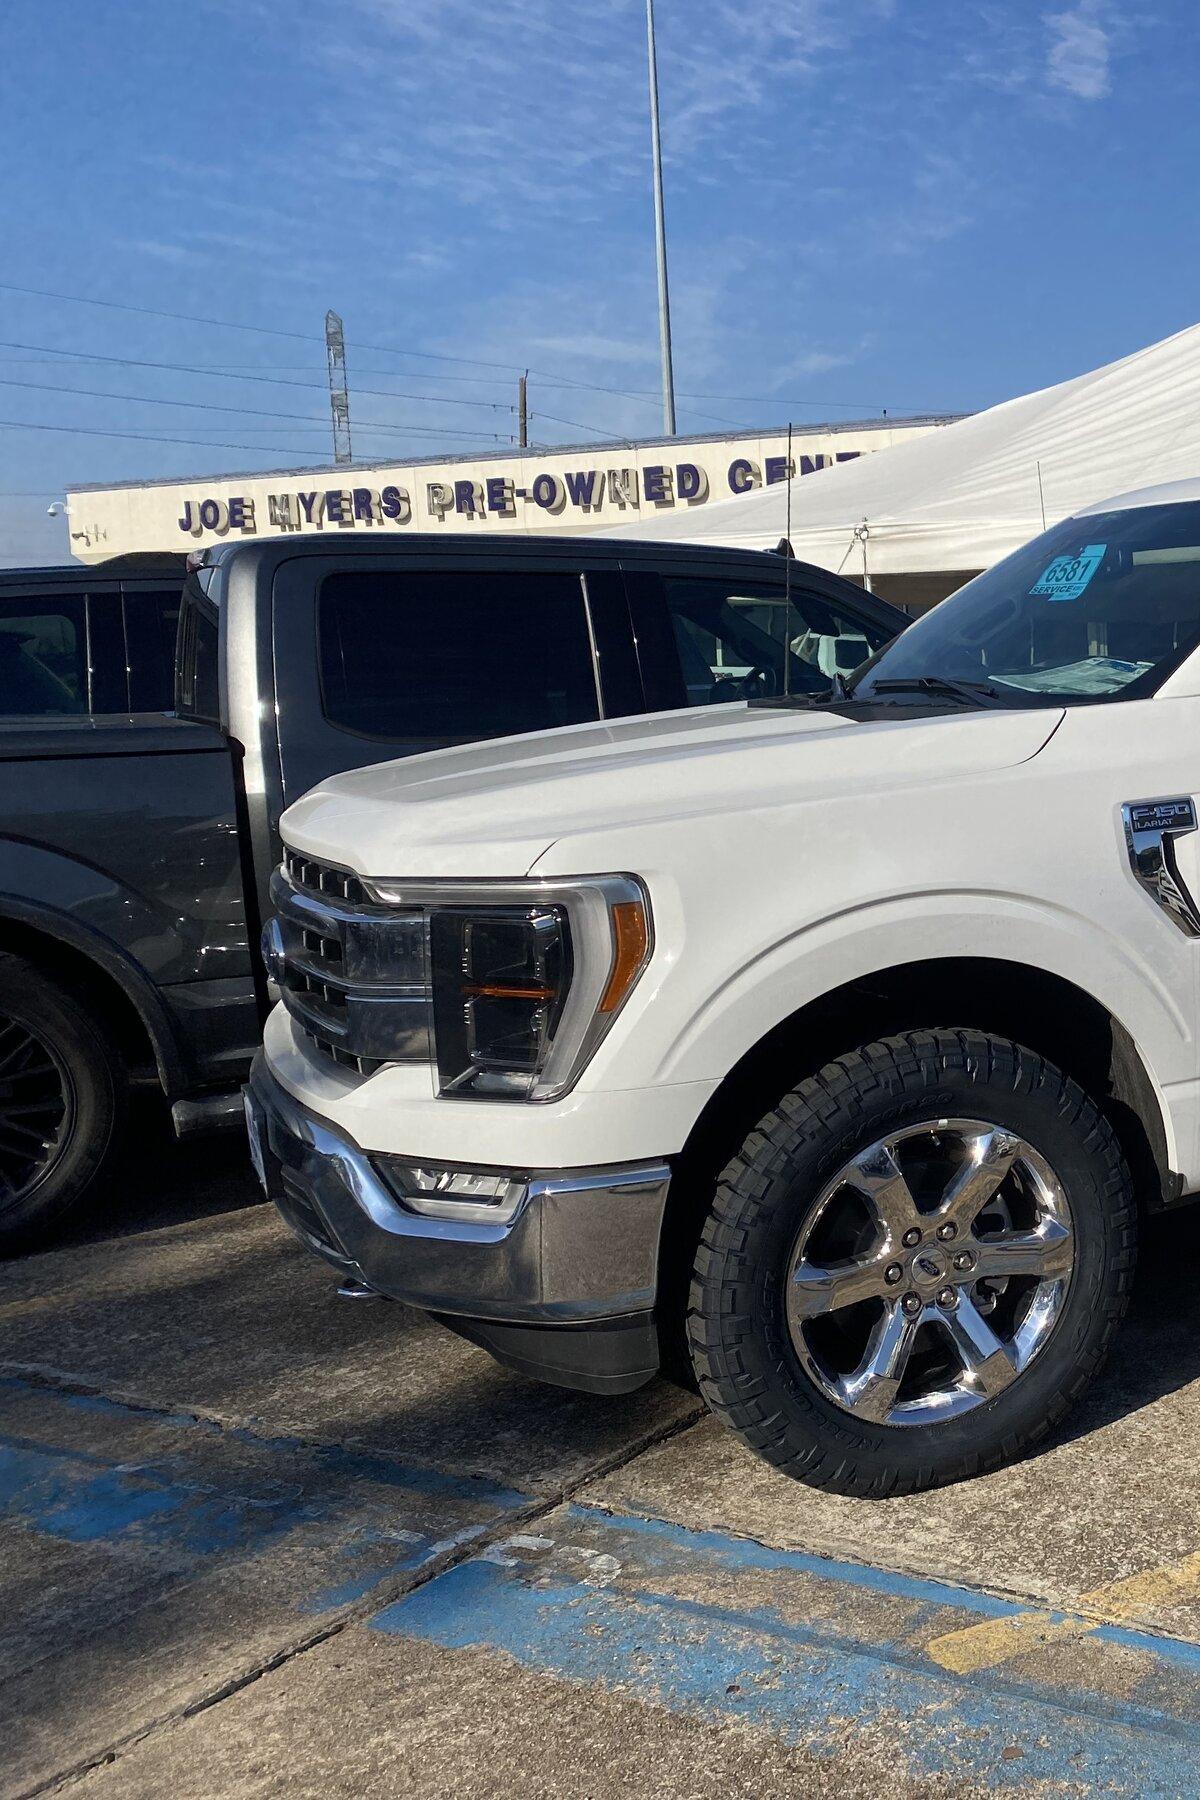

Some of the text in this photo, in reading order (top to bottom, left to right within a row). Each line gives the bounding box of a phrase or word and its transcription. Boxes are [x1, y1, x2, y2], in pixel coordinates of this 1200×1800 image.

[178, 450, 880, 533] JOE MYERS PRE-OWNED CEN
[1046, 560, 1092, 583] 6581
[1031, 585, 1075, 594] SERVICE
[1132, 804, 1191, 820] F-150
[1135, 819, 1173, 829] LARIAT
